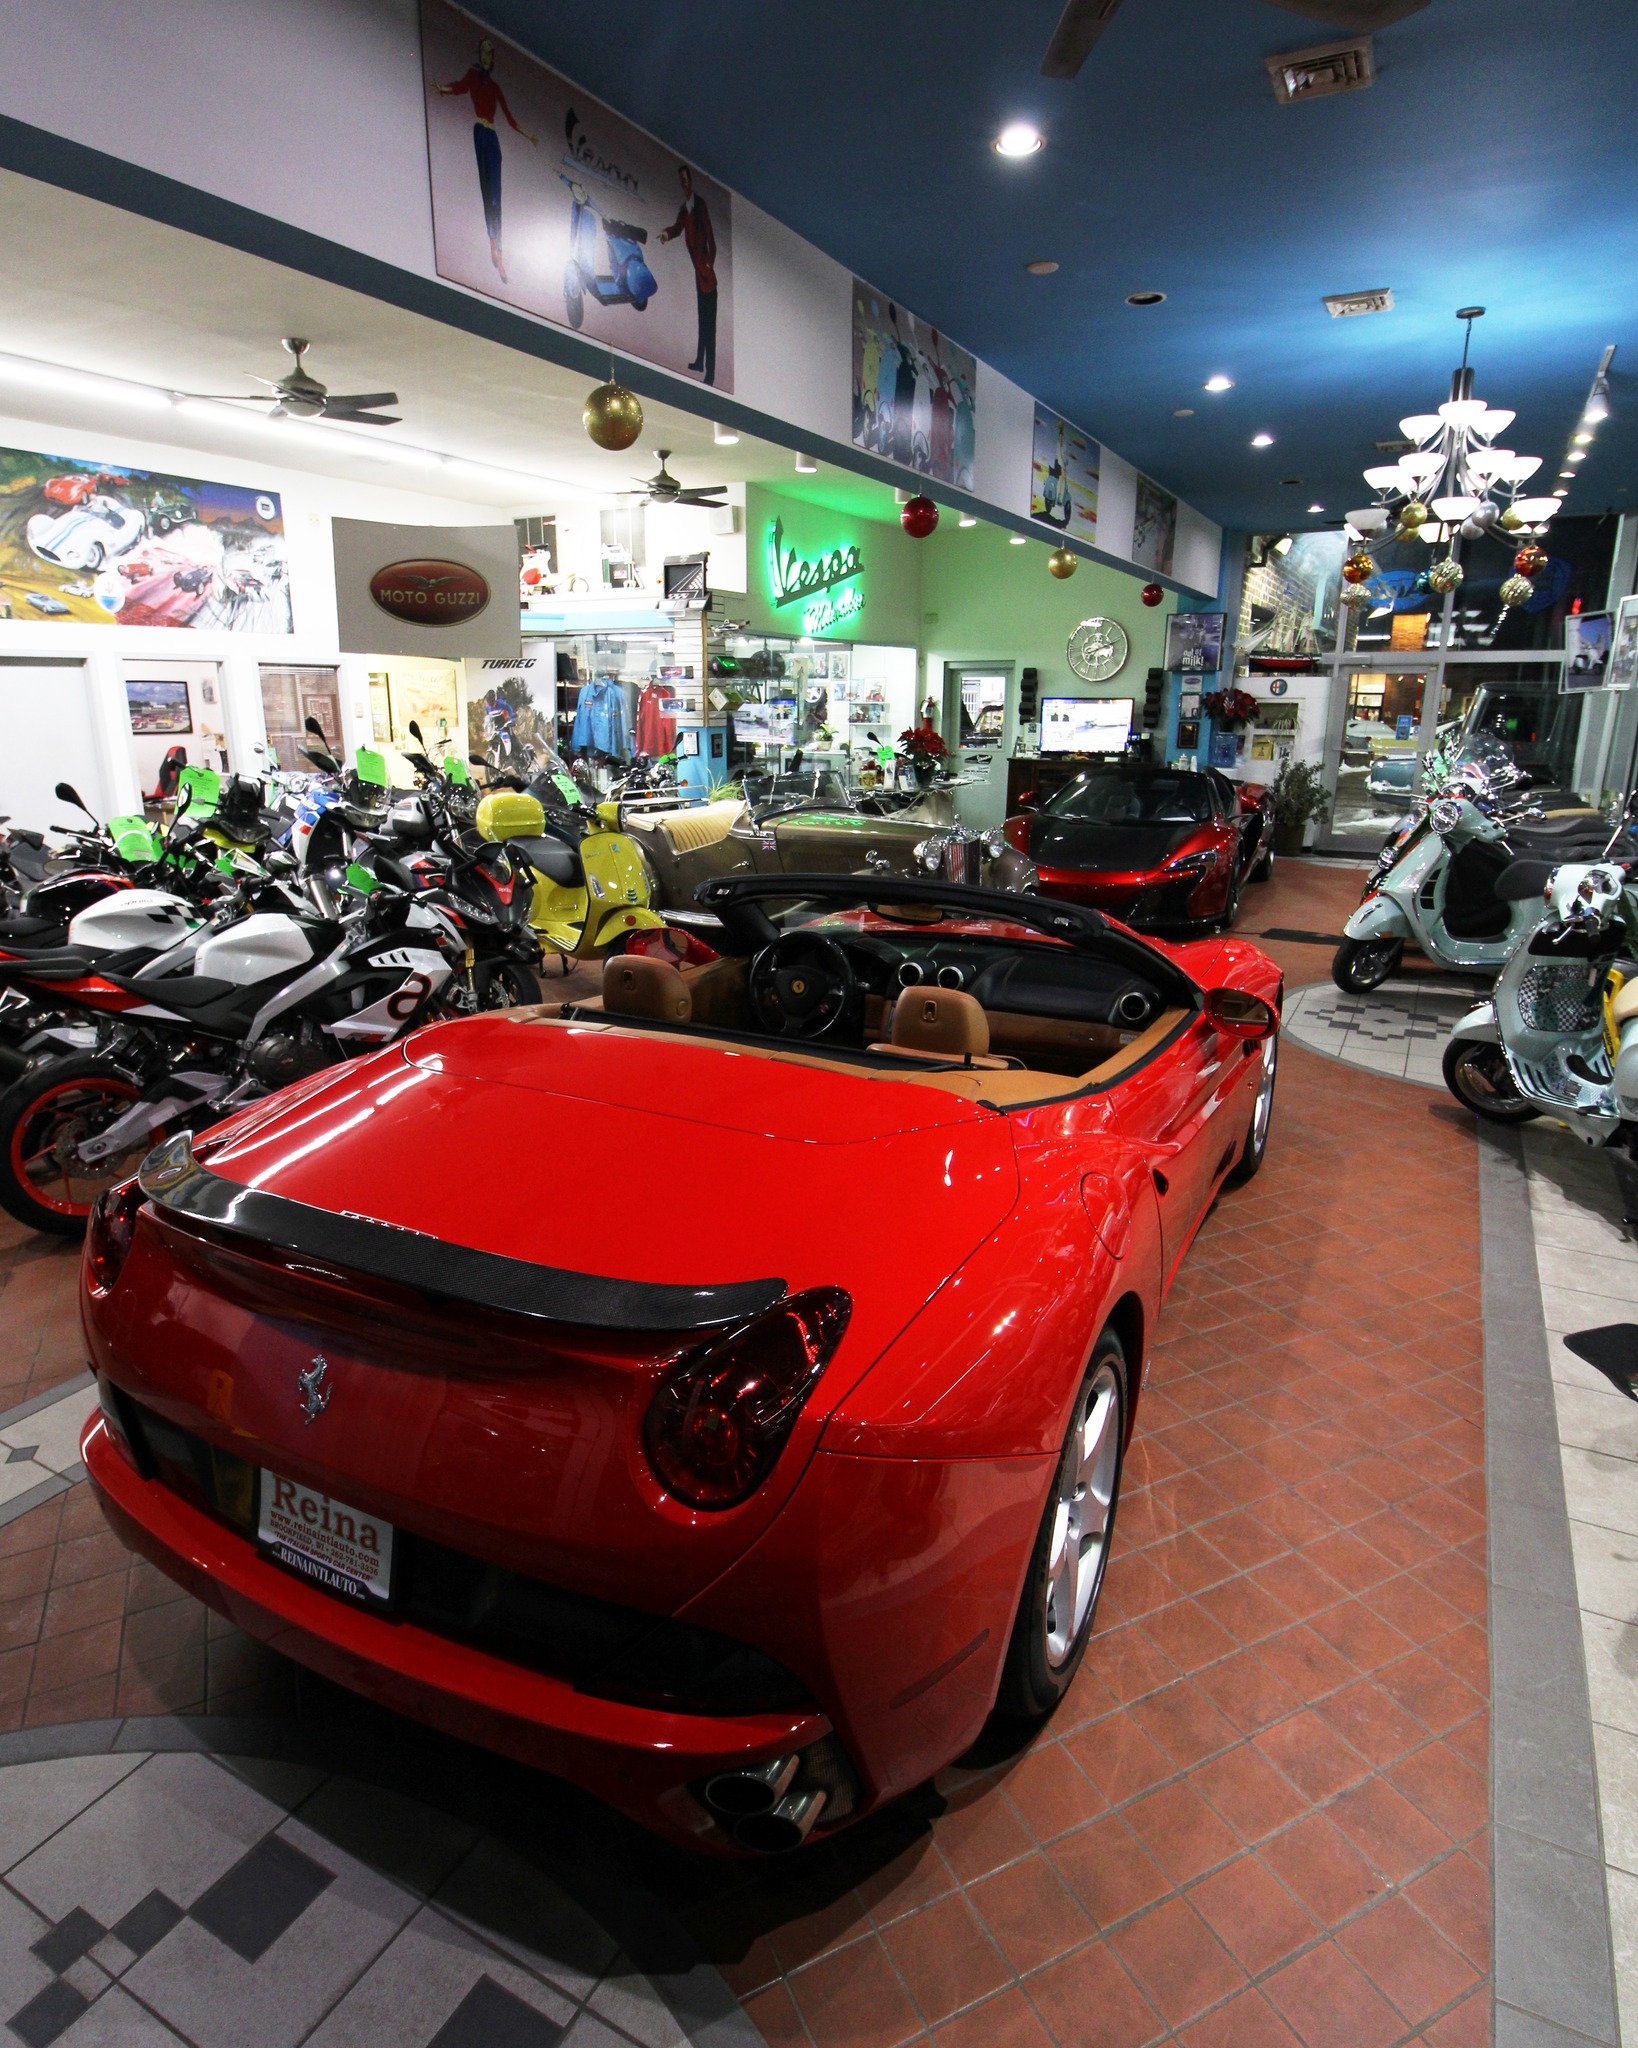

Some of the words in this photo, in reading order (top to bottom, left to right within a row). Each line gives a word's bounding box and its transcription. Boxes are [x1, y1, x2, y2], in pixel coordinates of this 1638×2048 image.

[562, 107, 641, 199] Vespa
[774, 515, 865, 608] Vespa
[380, 589, 428, 605] MOTO
[433, 592, 481, 606] GUZZI
[481, 658, 537, 670] TUAREG
[1182, 655, 1204, 666] milk!
[271, 1474, 380, 1555] Reina
[270, 1510, 380, 1567] www.reinaintlauto.com
[287, 1537, 310, 1553] ITALIAN
[310, 1548, 332, 1565] SPORTS
[332, 1558, 346, 1571] CAR
[330, 1547, 379, 1576] 262-781-3336
